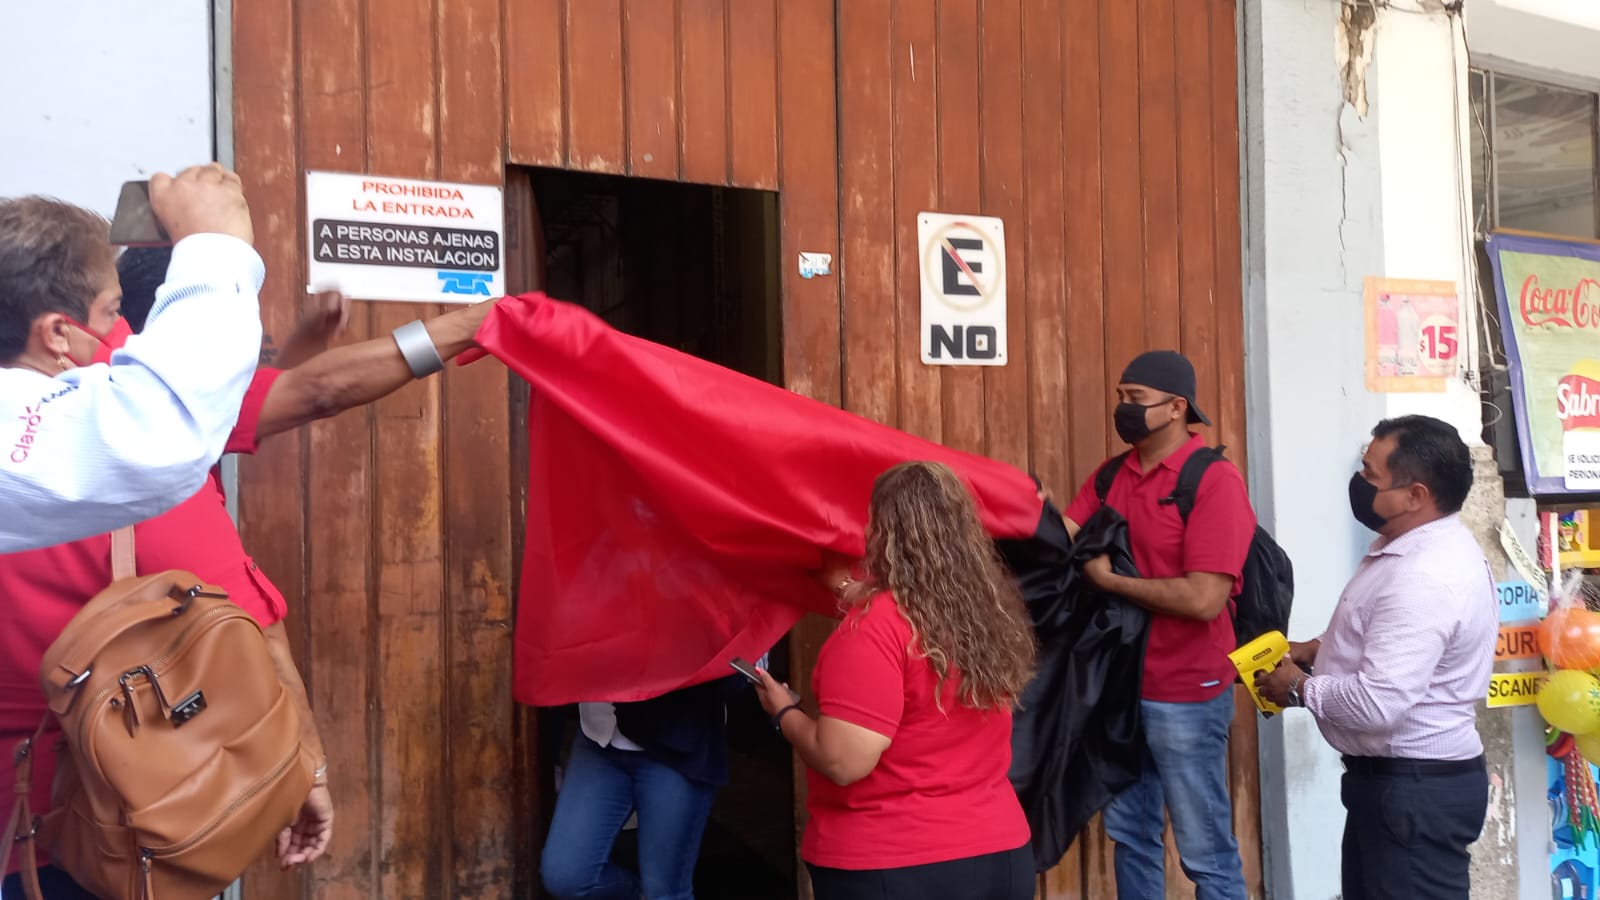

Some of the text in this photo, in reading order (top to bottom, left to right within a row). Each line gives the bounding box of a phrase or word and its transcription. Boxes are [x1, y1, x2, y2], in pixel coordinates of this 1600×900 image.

[362, 181, 464, 200] PROHIBIDA
[352, 199, 474, 219] LA ENTRADA
[320, 224, 494, 249] A PERSONAS AJENAS
[319, 243, 495, 267] A ESTA INSTALACION
[941, 238, 984, 296] E
[930, 323, 997, 359] NO
[1557, 382, 1600, 420] Sabr
